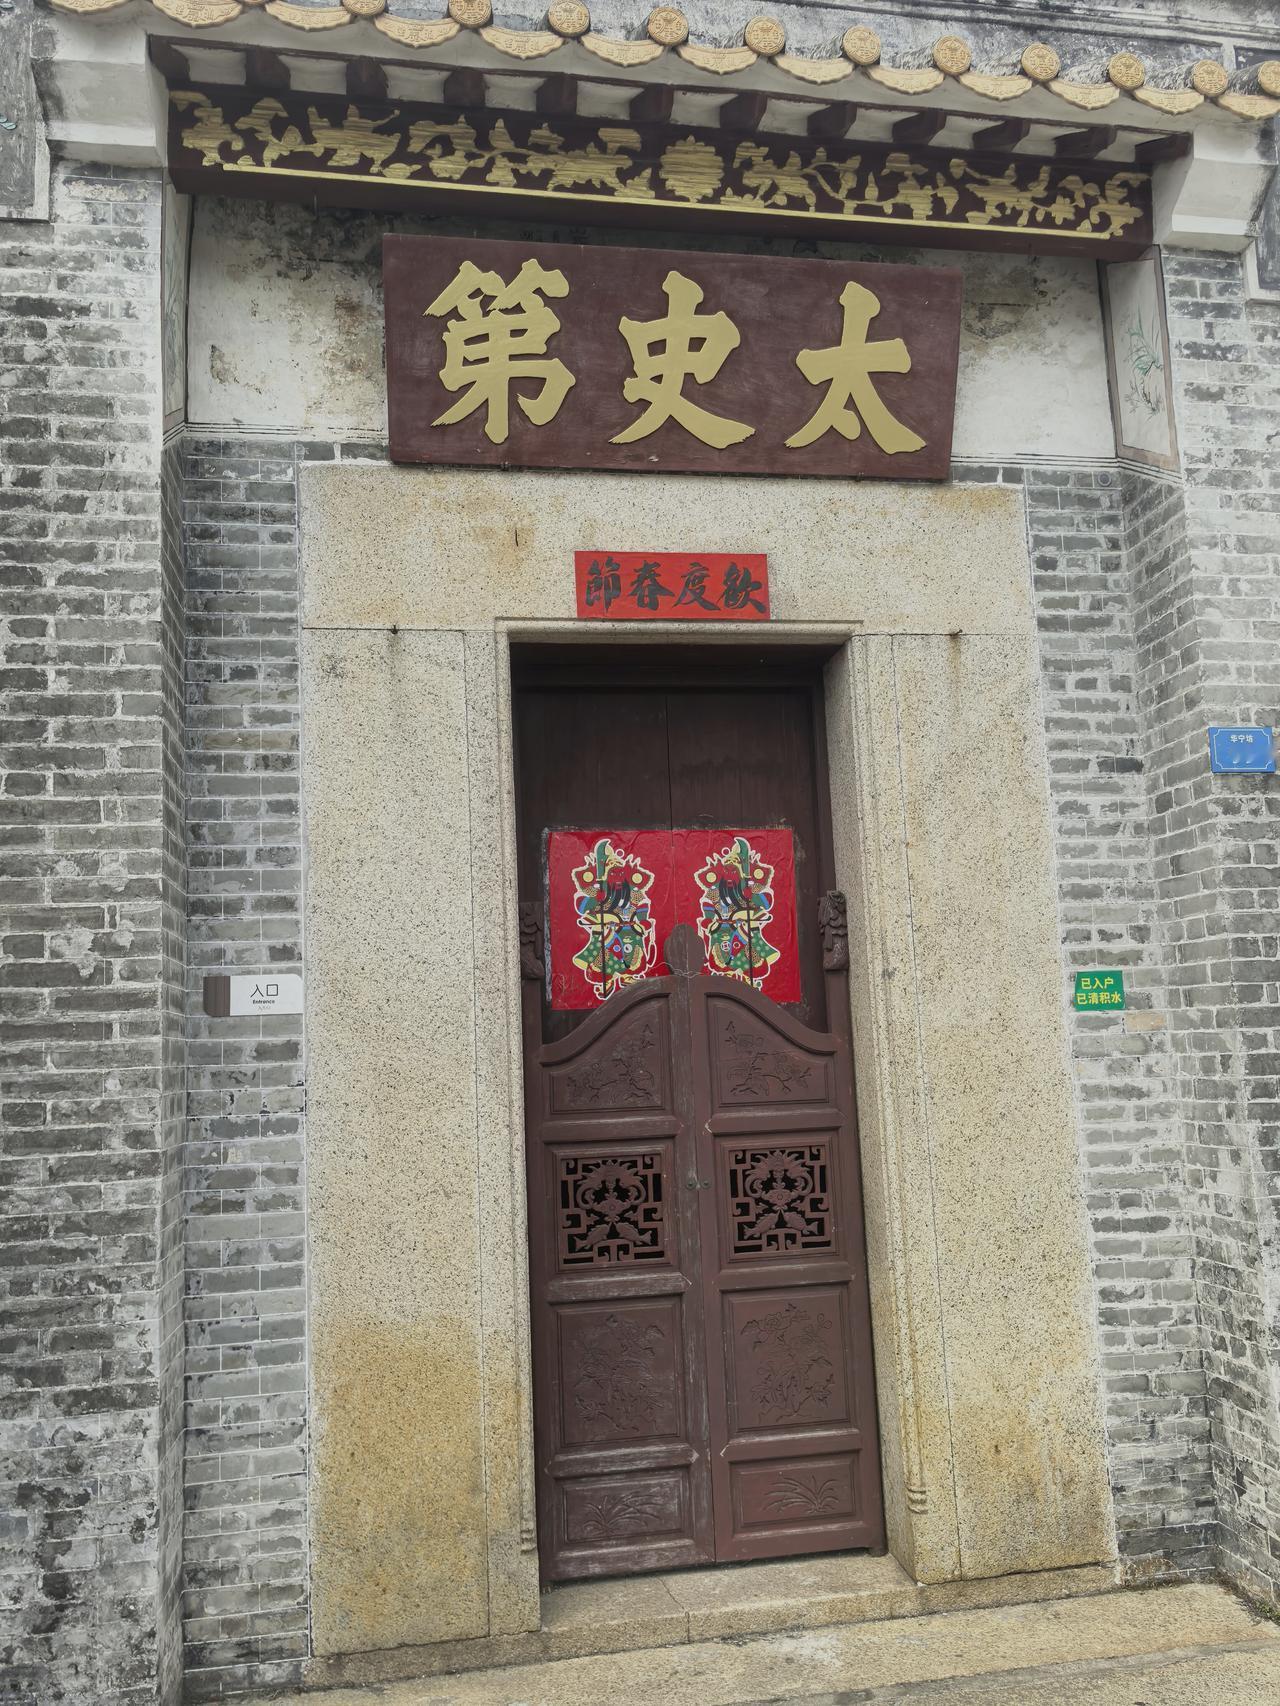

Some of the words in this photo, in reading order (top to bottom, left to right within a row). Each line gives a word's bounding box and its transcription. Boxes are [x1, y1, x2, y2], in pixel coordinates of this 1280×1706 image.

[422, 258, 927, 455] 太史第
[1081, 977, 1114, 989] 已入户
[250, 984, 278, 998] 入口
[1076, 991, 1121, 1004] 已清积水
